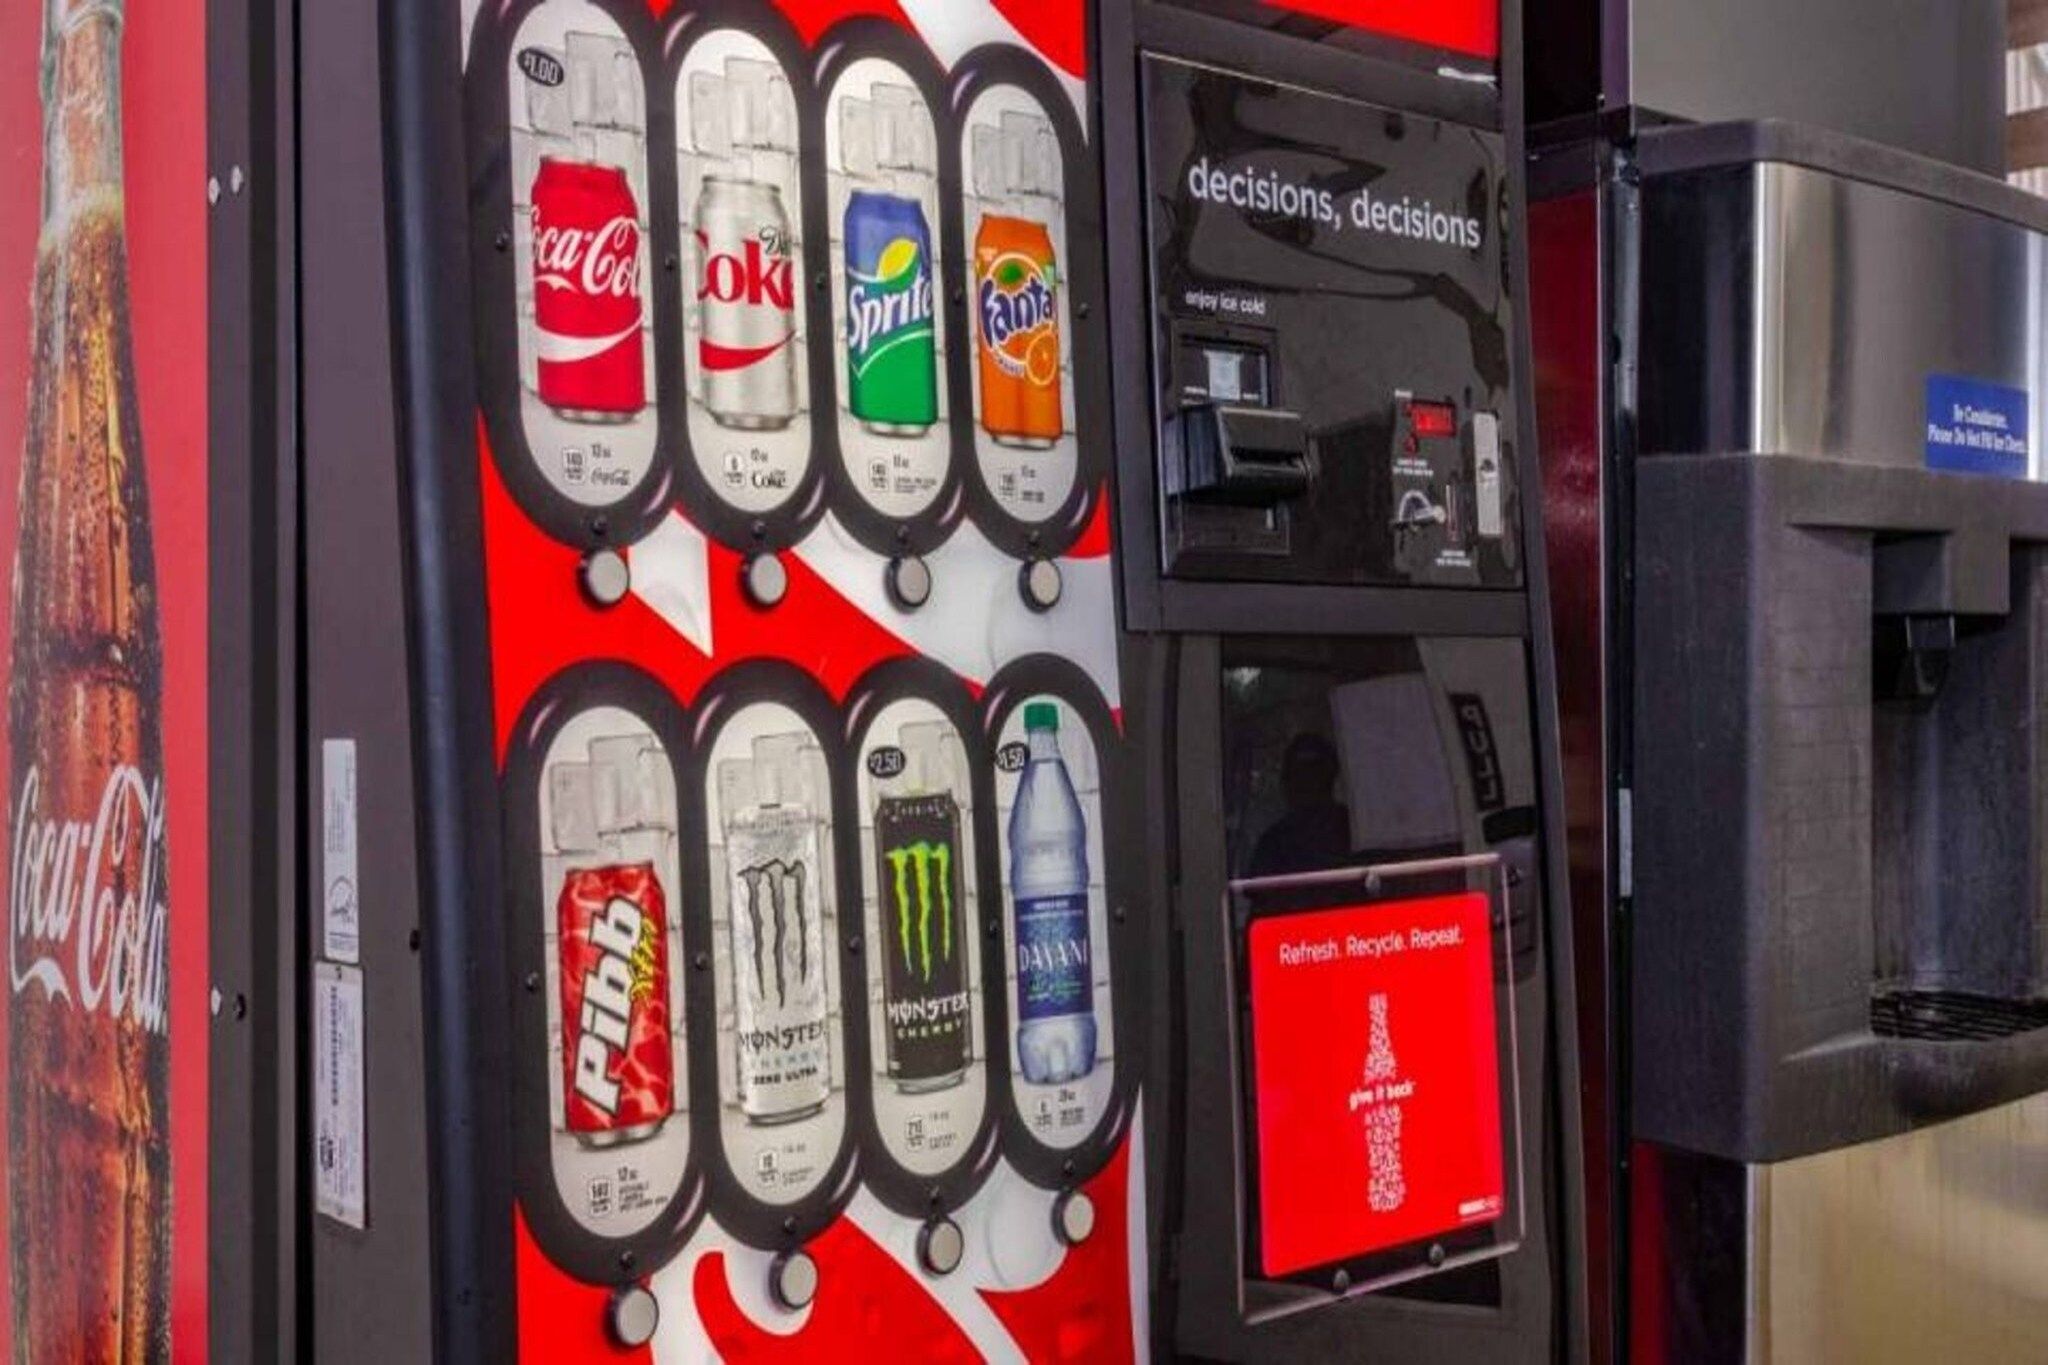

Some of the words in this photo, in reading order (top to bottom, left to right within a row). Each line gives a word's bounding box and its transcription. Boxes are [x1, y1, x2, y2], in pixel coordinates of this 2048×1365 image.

[1189, 157, 1342, 230] decisions,
[1350, 189, 1482, 249] decisions
[574, 893, 643, 1119] Pibb
